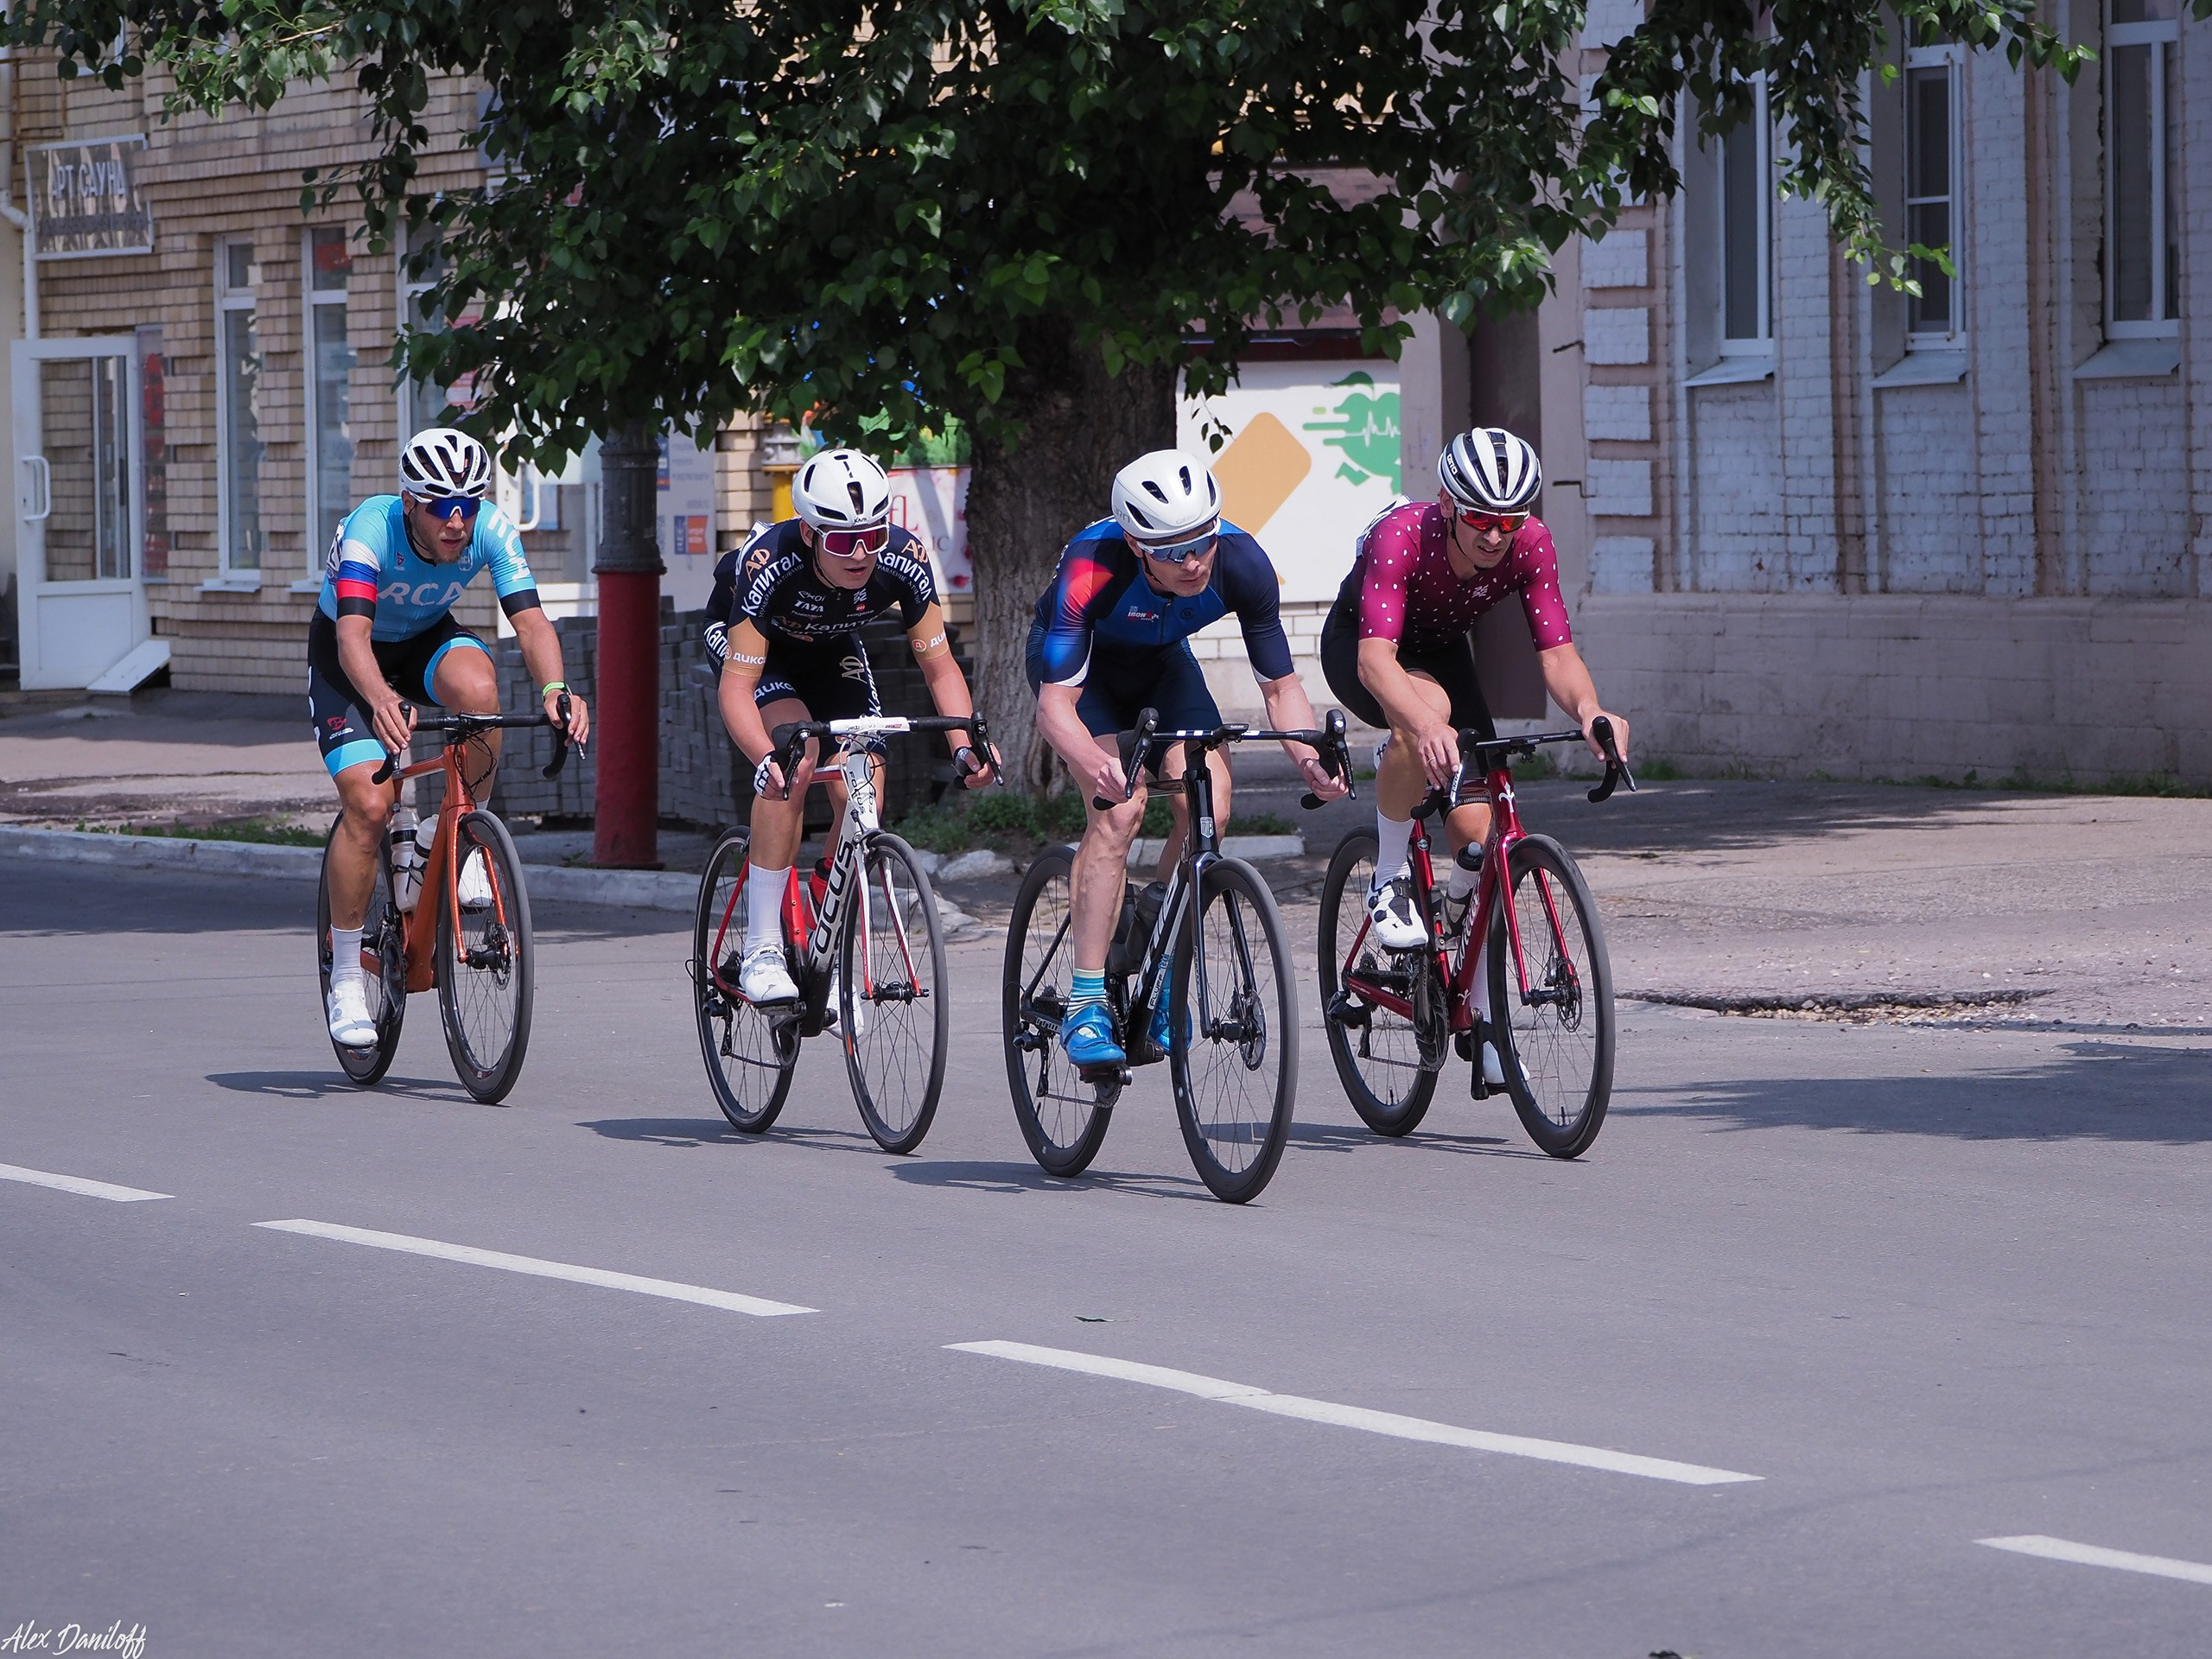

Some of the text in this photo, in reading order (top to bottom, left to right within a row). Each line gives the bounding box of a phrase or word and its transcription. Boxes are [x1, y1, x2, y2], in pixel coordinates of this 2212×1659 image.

[79, 159, 130, 198] САУНА
[378, 582, 466, 606] RCA
[741, 551, 803, 617] Капитал
